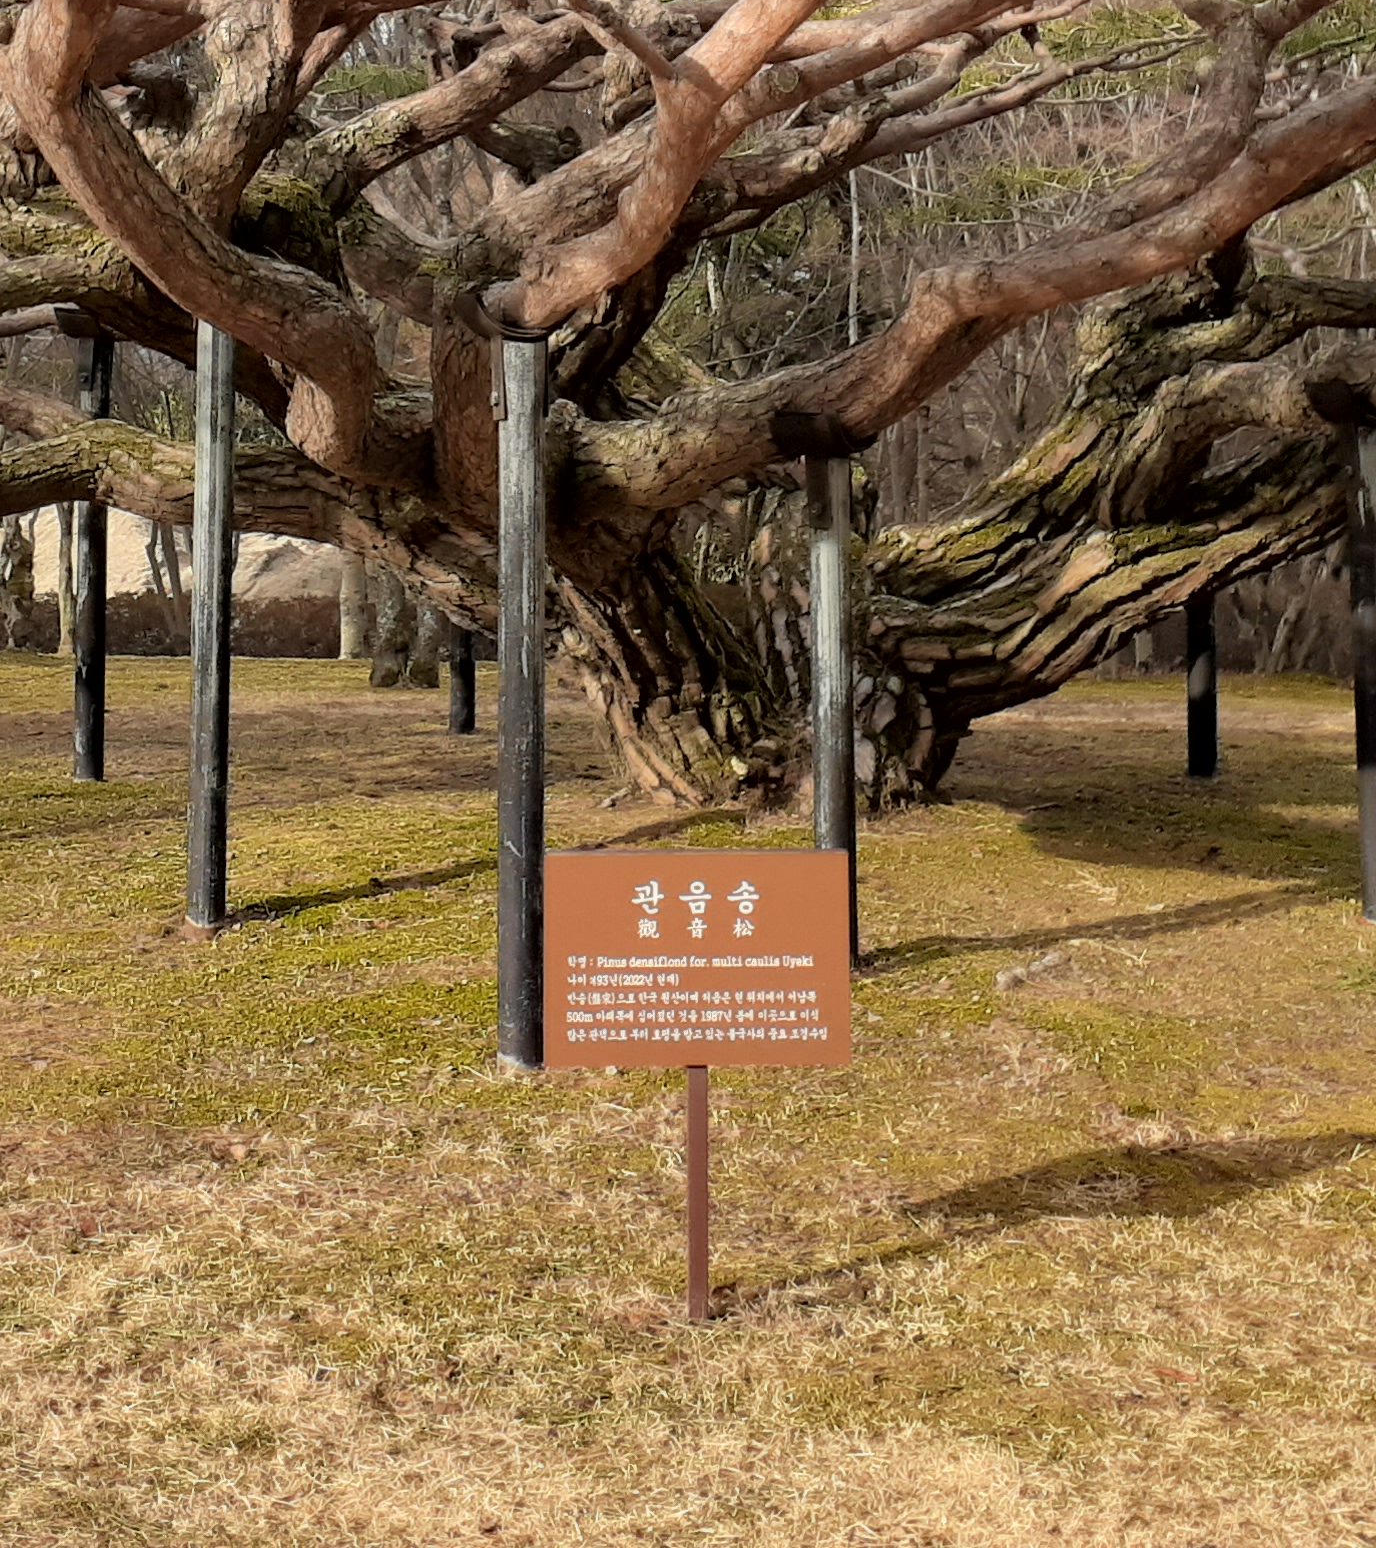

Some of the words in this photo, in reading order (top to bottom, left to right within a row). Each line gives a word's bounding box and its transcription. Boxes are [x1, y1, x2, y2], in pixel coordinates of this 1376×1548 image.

[596, 954, 627, 968] Pinus
[711, 954, 744, 968] multi
[745, 954, 781, 968] caulis
[781, 954, 814, 969] Uyeki
[566, 972, 587, 987] 나이
[638, 990, 658, 1005] 한국
[745, 990, 785, 1005] 위치에서
[566, 1010, 594, 1023] 500m
[799, 1008, 819, 1023] 이식
[726, 1027, 765, 1042] 불국사의
